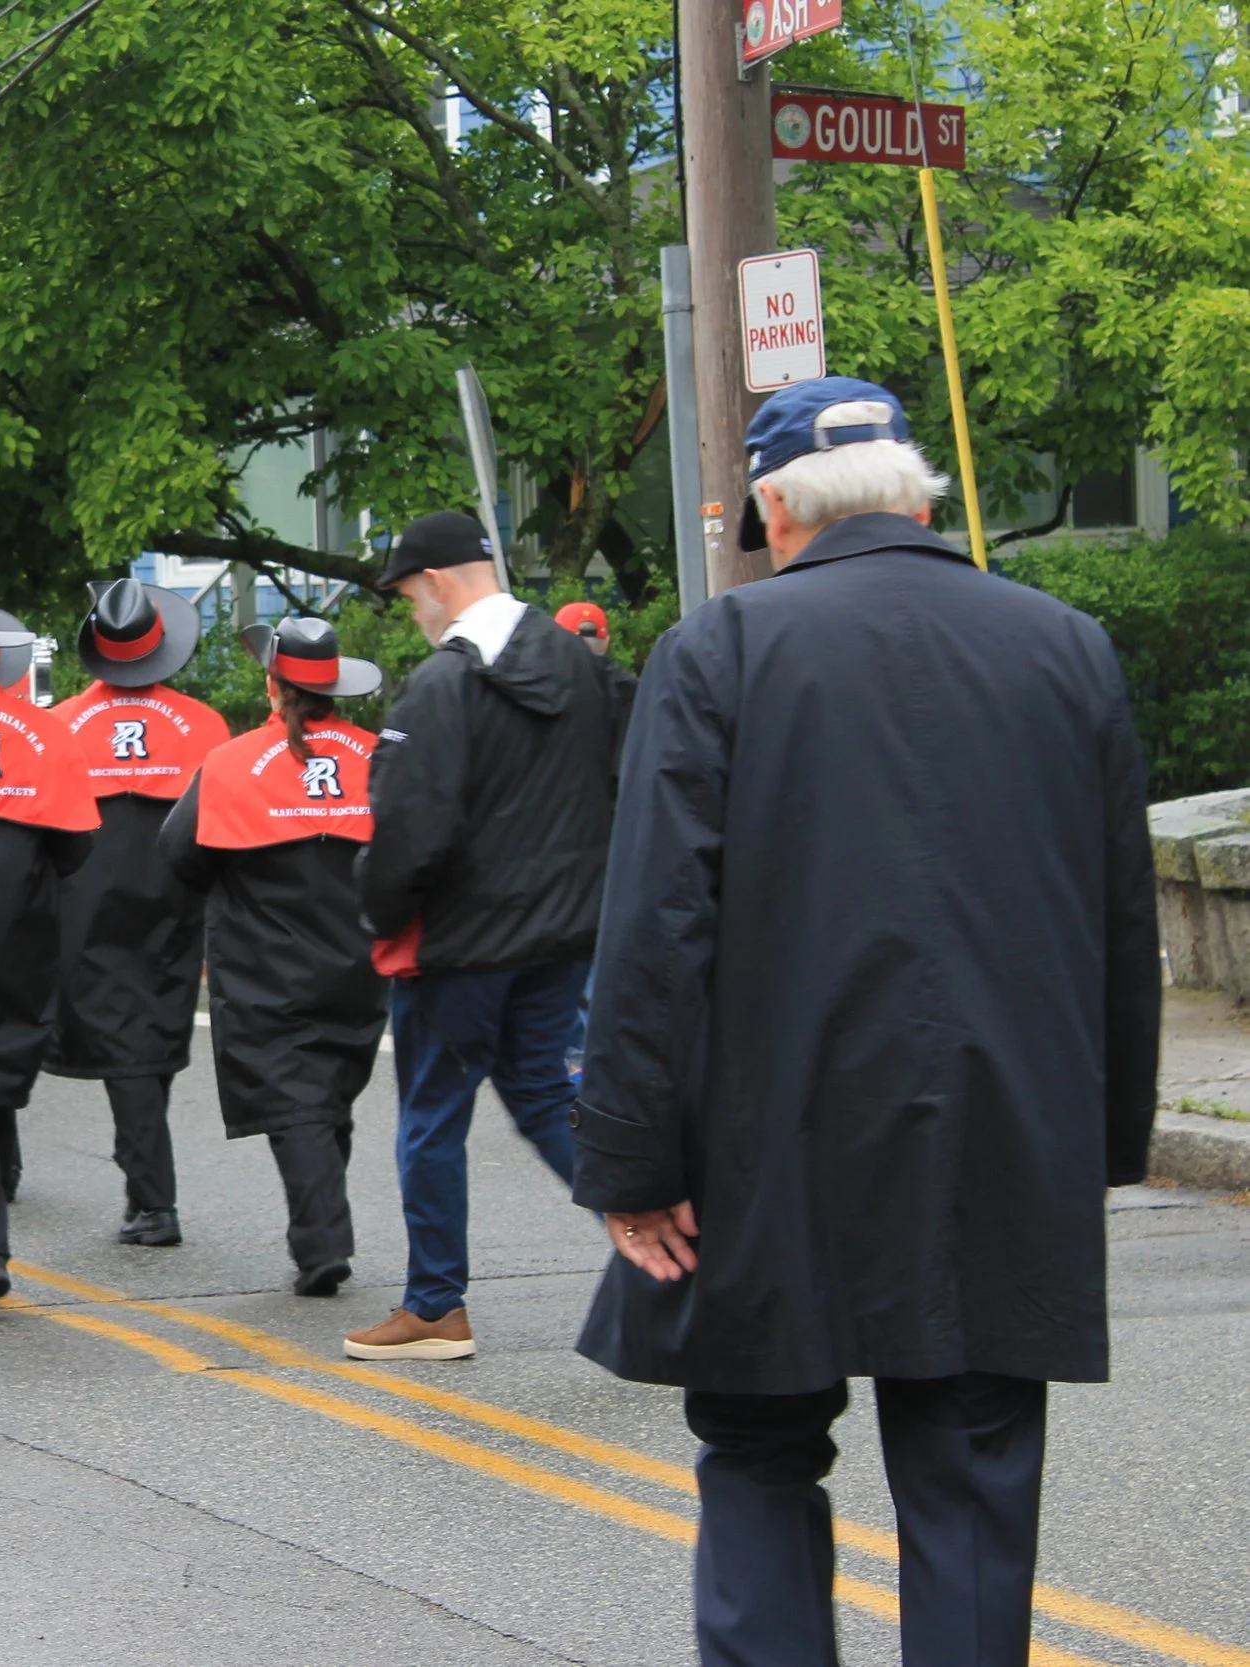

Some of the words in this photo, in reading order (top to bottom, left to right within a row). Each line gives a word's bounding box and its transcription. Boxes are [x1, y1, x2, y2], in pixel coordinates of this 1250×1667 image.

[770, 0, 808, 40] ASH
[815, 105, 923, 156] GOULD
[938, 114, 960, 146] ST
[766, 292, 794, 318] NO
[750, 320, 816, 352] PARKING
[69, 701, 110, 735] EADING
[111, 697, 174, 718] MEMORIAL
[107, 719, 150, 760] R
[251, 738, 289, 776] READIN
[88, 767, 133, 776] ARCHING
[134, 766, 182, 775] ROCKETS
[298, 756, 344, 799] R
[268, 807, 327, 817] MARCHING
[329, 806, 371, 816] ROCKET
